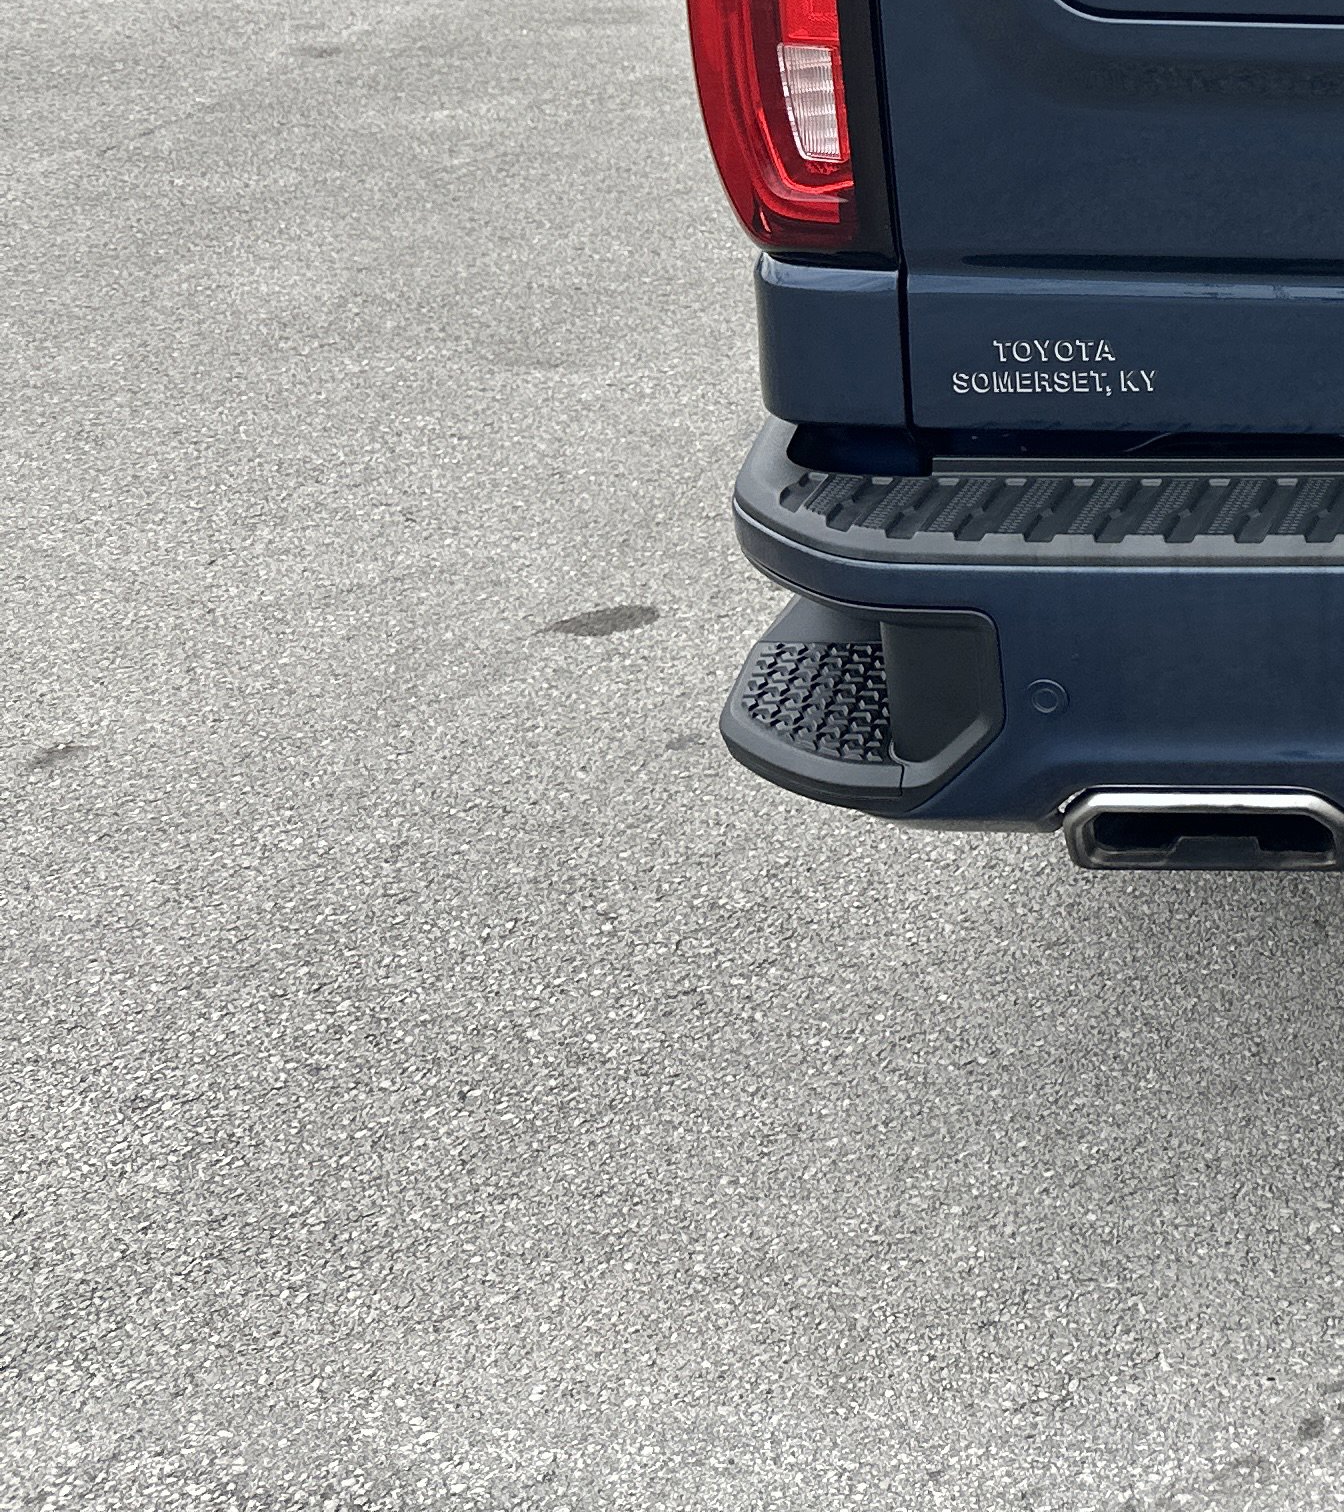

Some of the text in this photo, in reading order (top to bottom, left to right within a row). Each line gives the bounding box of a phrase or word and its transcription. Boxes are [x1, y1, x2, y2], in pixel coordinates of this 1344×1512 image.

[992, 339, 1116, 362] TOYOTA
[952, 370, 1157, 397] SOMERSET, KY
